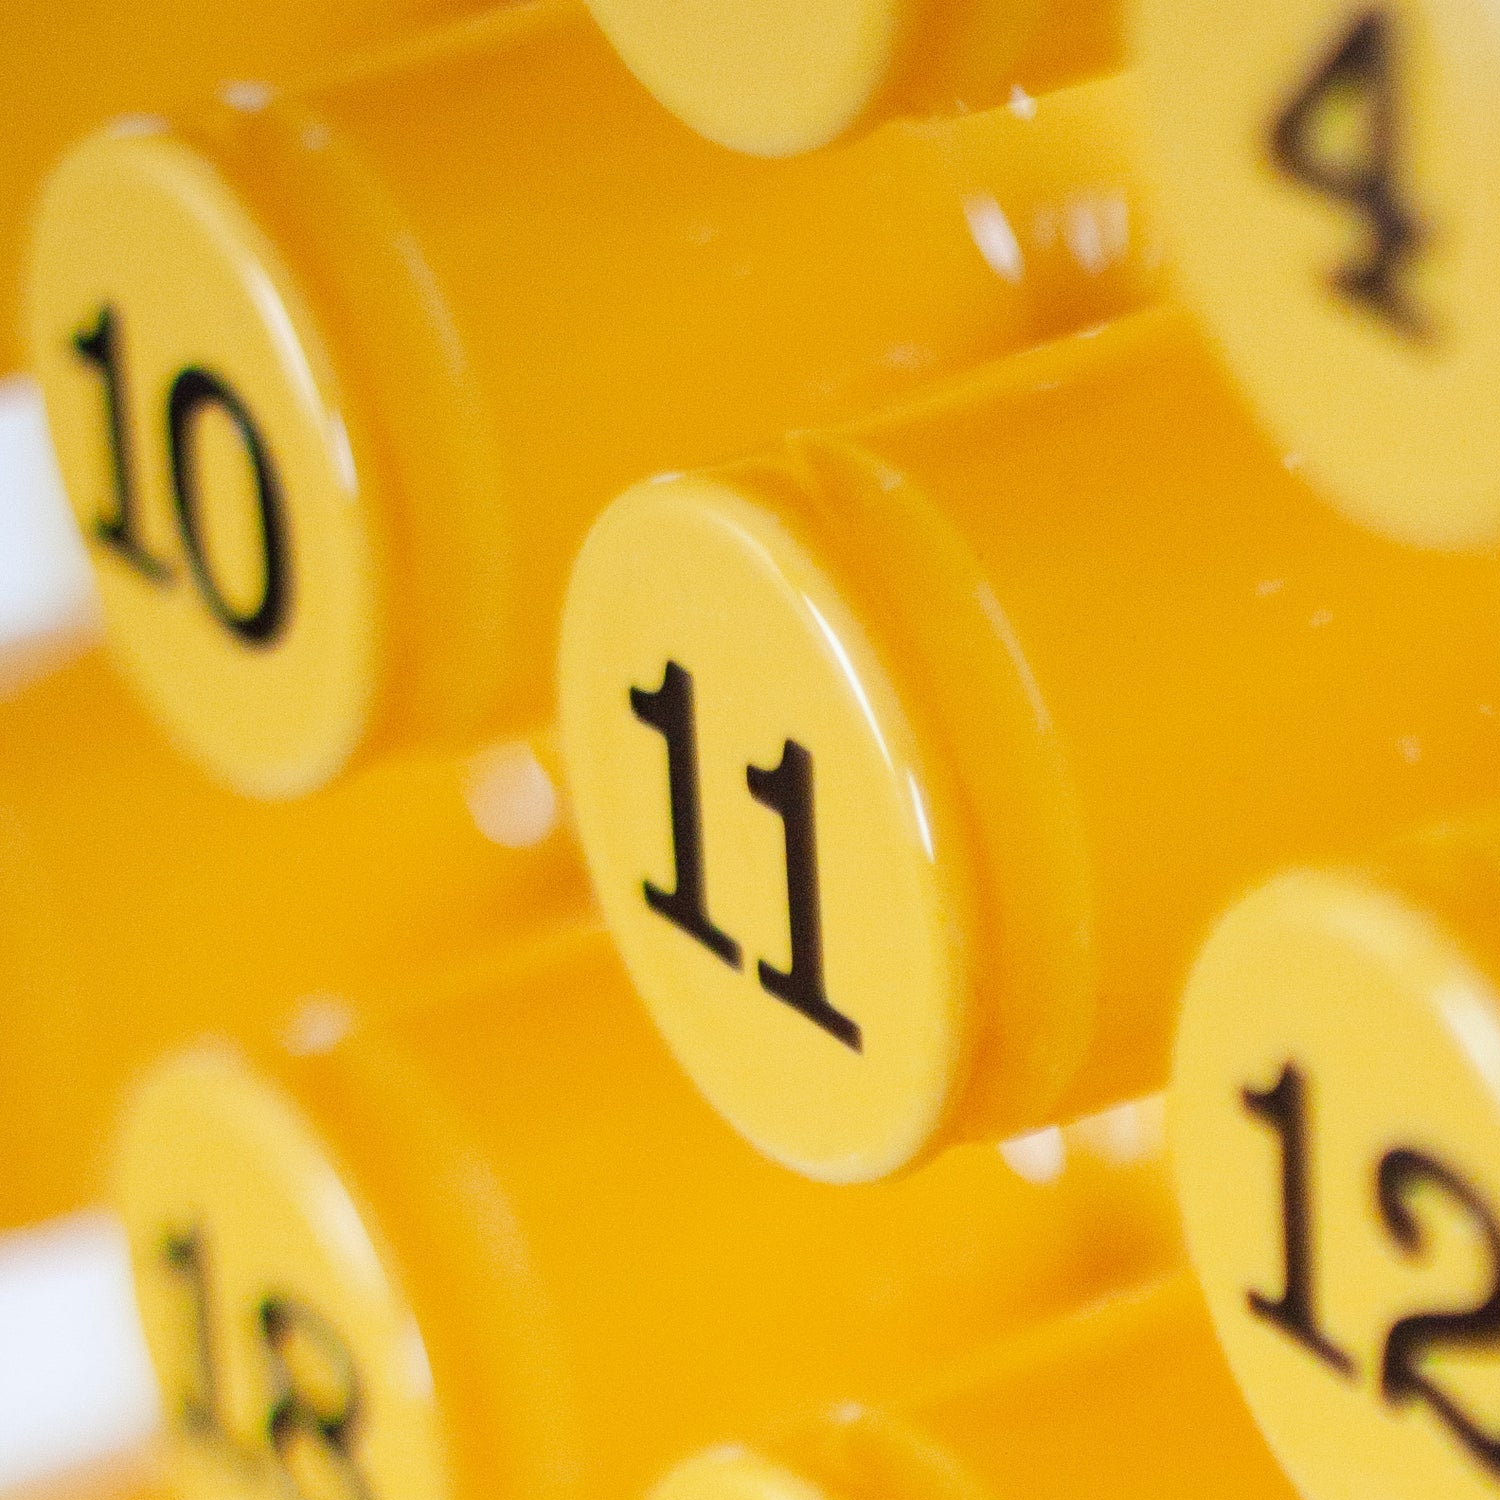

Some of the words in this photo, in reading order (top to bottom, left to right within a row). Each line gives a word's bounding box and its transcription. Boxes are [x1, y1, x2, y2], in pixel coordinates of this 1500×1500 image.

[1260, 0, 1436, 340] 4
[67, 303, 295, 652] 10
[627, 658, 862, 1052] 11
